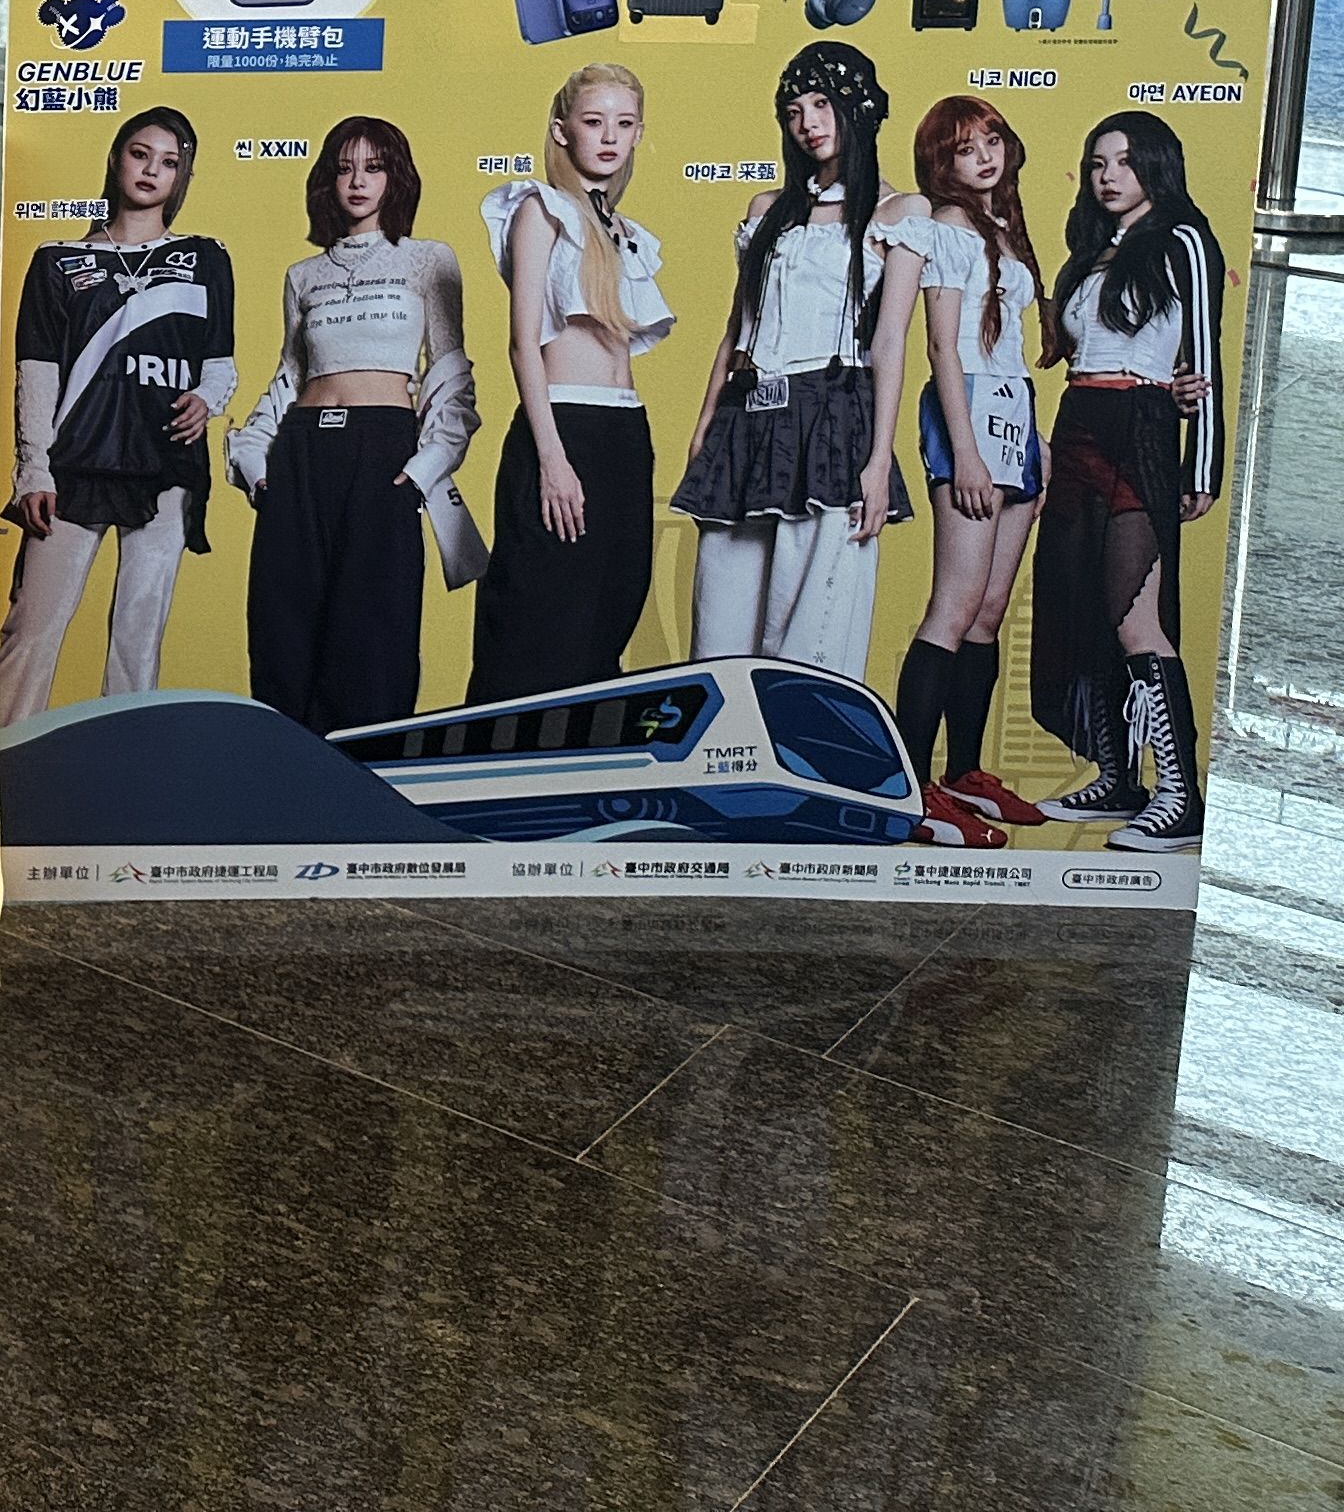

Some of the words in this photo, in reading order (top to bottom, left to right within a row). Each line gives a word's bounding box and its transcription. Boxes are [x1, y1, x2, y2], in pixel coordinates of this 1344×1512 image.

[202, 26, 344, 51] 運動手機臂包
[17, 61, 143, 83] GENBLUE
[969, 71, 1003, 88] 니코
[1009, 70, 1057, 88] NICO
[15, 87, 118, 111] 幻藍小熊
[1129, 83, 1165, 101] 아연
[1172, 85, 1242, 102] AYEON
[259, 140, 308, 158] XXIN
[479, 157, 508, 174] 리리
[685, 164, 732, 180] 아야코
[15, 202, 45, 218] 위엔
[703, 746, 757, 758] TMRT
[27, 865, 89, 880] 主辦單位
[150, 865, 278, 878] 臺中市政府捷運工程局
[512, 863, 572, 876] 協辦單位
